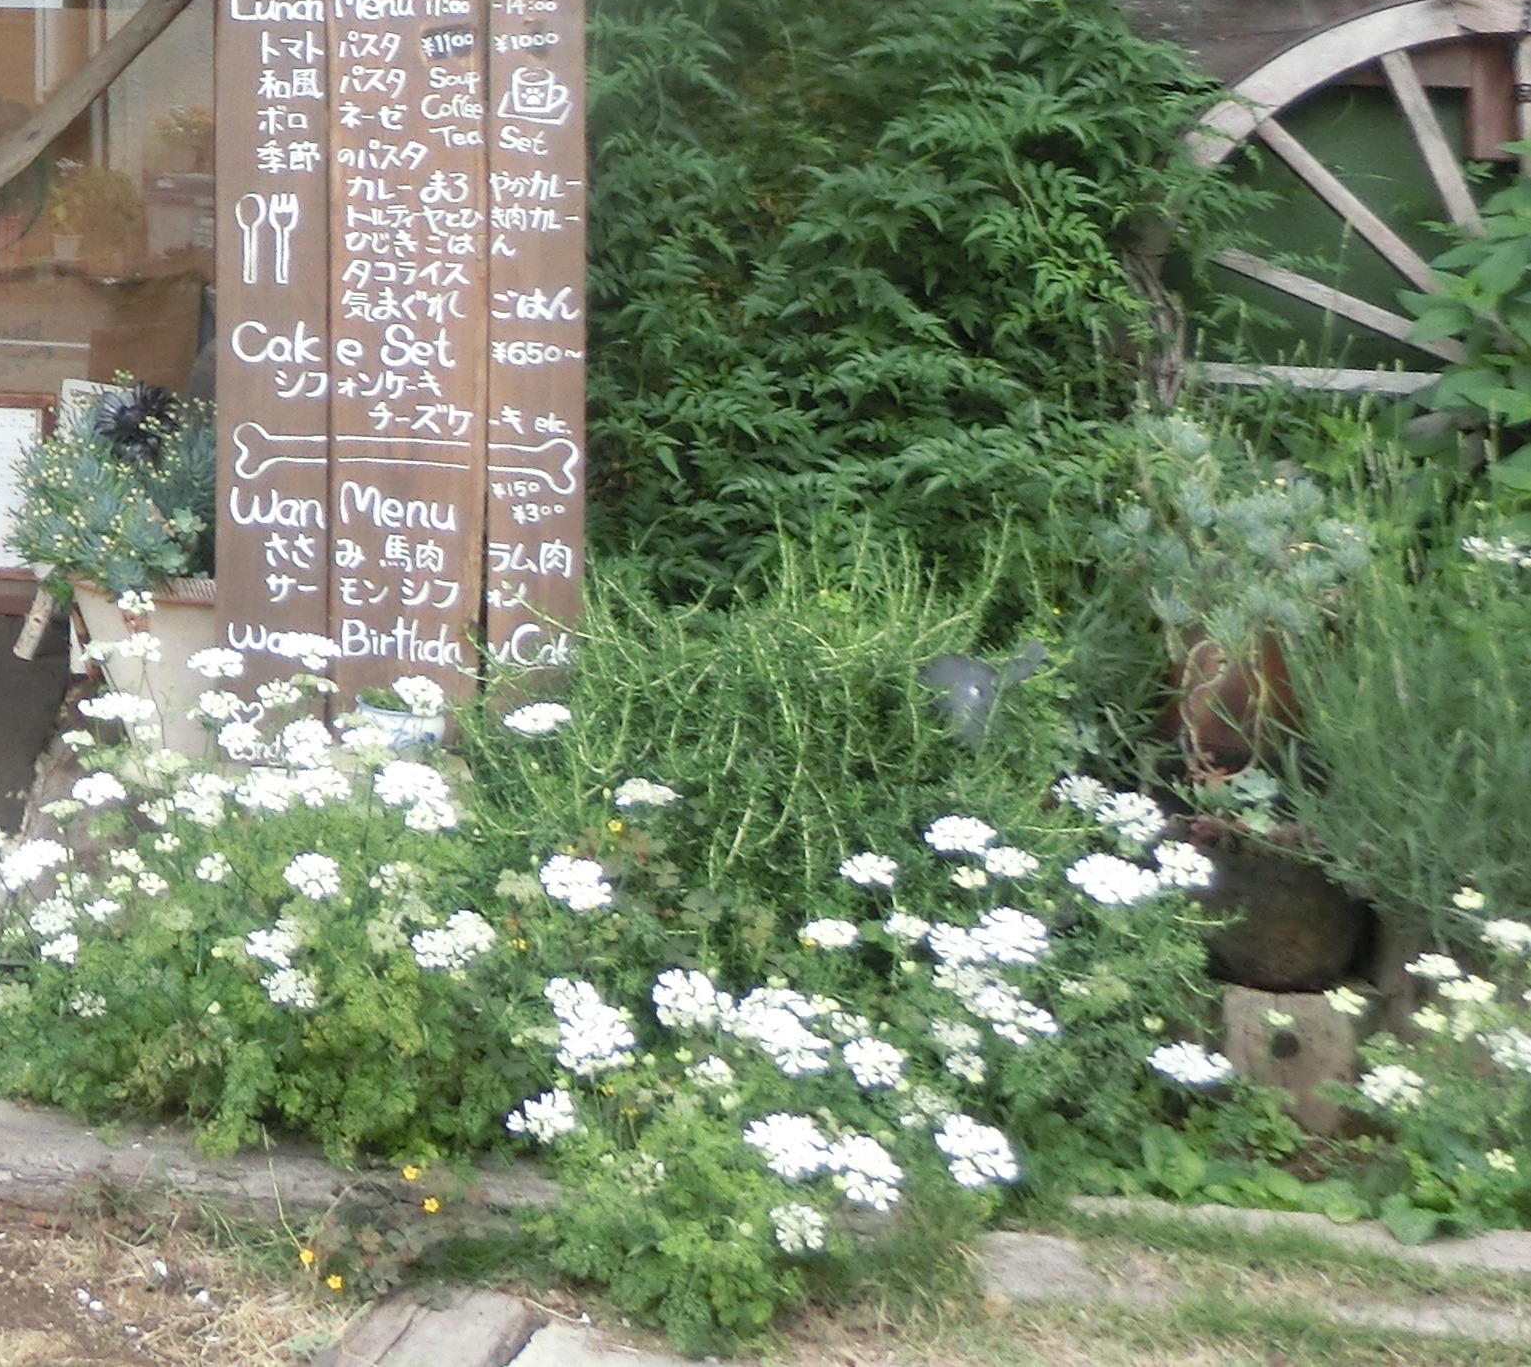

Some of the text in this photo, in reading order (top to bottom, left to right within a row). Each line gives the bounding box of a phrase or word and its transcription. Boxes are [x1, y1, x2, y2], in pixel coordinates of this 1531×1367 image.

[421, 31, 475, 58] ¥1100
[493, 32, 560, 55] ¥1000
[429, 66, 481, 95] Soup
[420, 94, 484, 120] Coffee
[428, 124, 549, 156] Tea Set
[341, 259, 472, 289] タコライス
[231, 320, 364, 365] Cake
[380, 323, 457, 369] Set
[491, 480, 541, 500] ¥150
[229, 480, 457, 532] Wan Menu
[511, 503, 566, 525] ¥300
